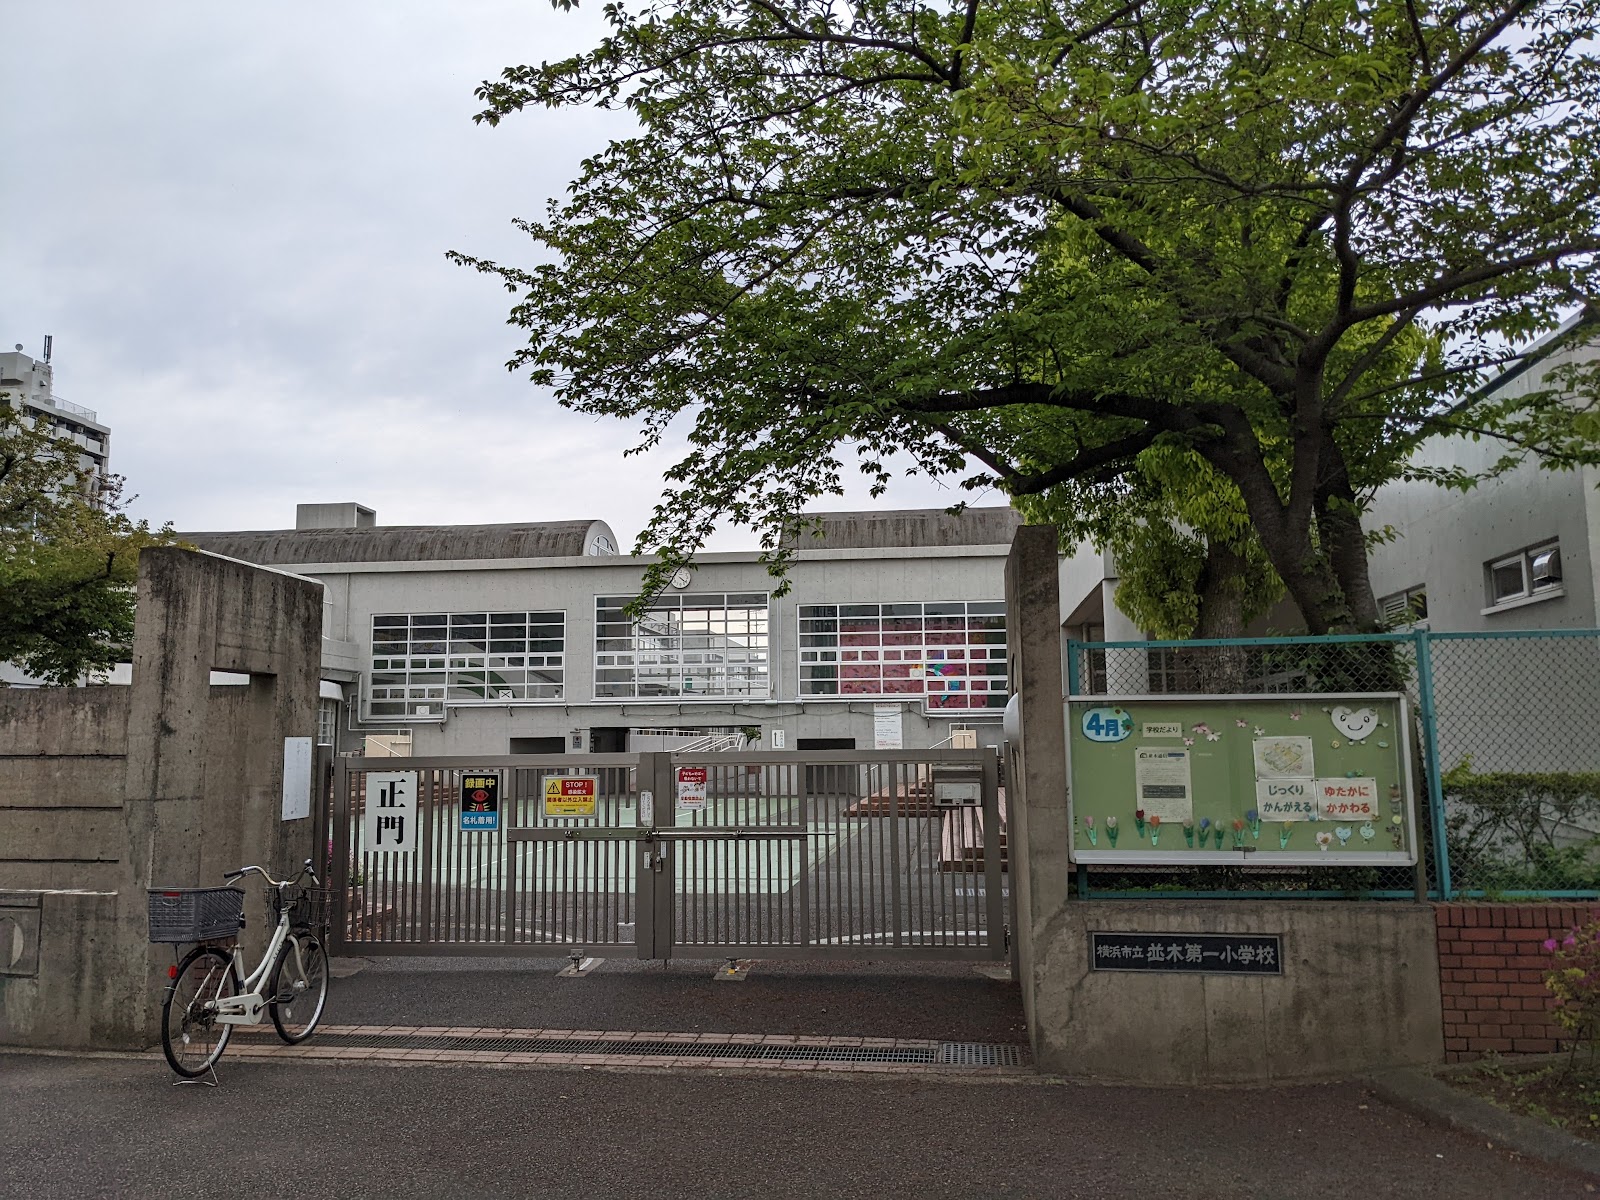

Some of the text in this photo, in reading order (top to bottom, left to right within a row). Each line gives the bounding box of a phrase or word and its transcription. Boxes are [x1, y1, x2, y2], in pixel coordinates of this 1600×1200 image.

[1086, 713, 1119, 736] 4月
[464, 777, 496, 789] 録画中
[1268, 784, 1304, 795] じっくり
[1324, 786, 1369, 797] ゆたかに
[376, 778, 406, 845] 正門
[1263, 801, 1312, 813] かんがえる
[1326, 802, 1370, 813] かかわる
[1096, 942, 1276, 965] 横浜市立 並木第一小学校
